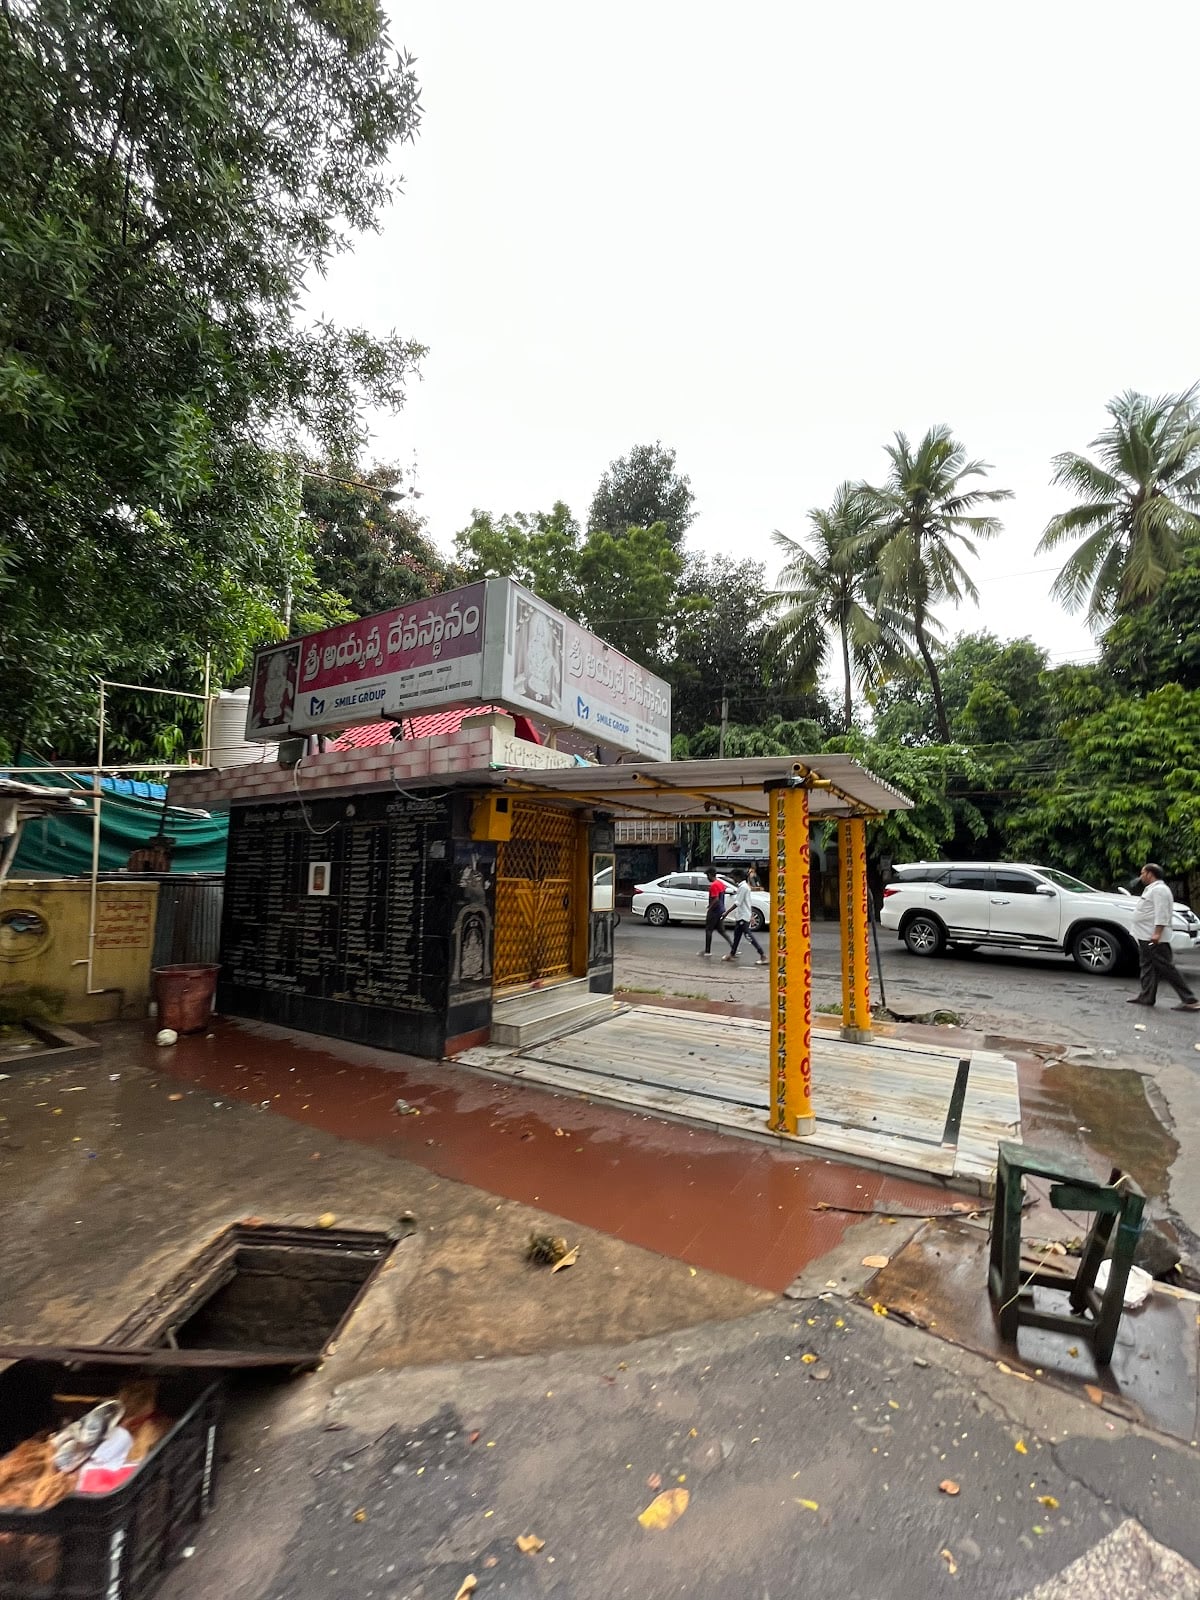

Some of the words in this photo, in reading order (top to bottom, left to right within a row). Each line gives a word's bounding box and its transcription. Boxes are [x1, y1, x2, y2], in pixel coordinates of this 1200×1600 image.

[303, 642, 320, 682] శ్రీ
[323, 626, 384, 670] అయ్యప్ప
[387, 602, 480, 660] దేవస్థానం
[334, 695, 357, 708] SMILE
[358, 689, 386, 704] GROUP
[596, 713, 612, 727] SMILE
[612, 720, 630, 733] GROUP
